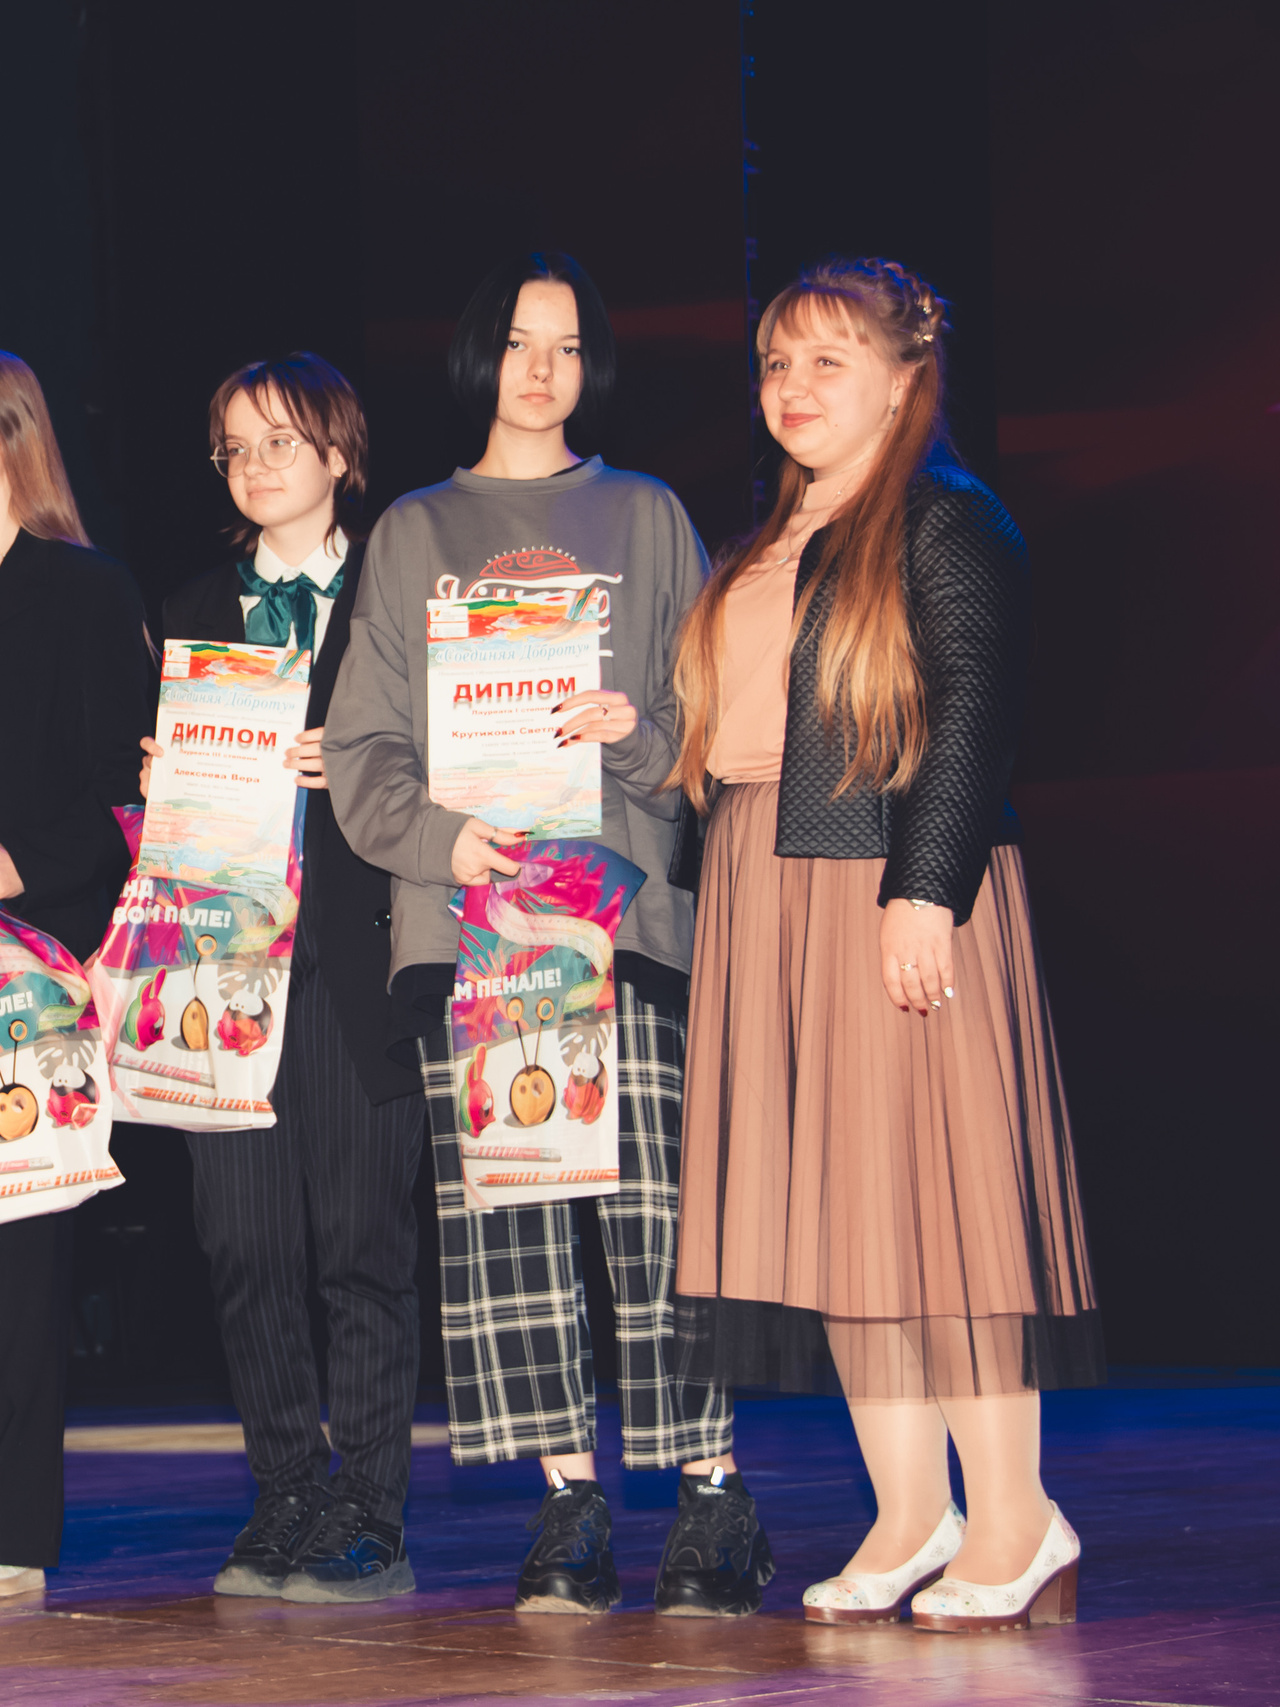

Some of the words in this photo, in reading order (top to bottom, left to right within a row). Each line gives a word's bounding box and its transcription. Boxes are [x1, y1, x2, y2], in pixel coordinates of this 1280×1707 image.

[453, 677, 576, 703] ДИПЛОМ
[172, 722, 277, 747] ДИПЛОМ
[452, 727, 515, 739] Крутикова
[174, 768, 227, 779] Алексеева
[231, 773, 261, 784] Вера
[476, 967, 562, 999] ПЕНАЛЕ!
